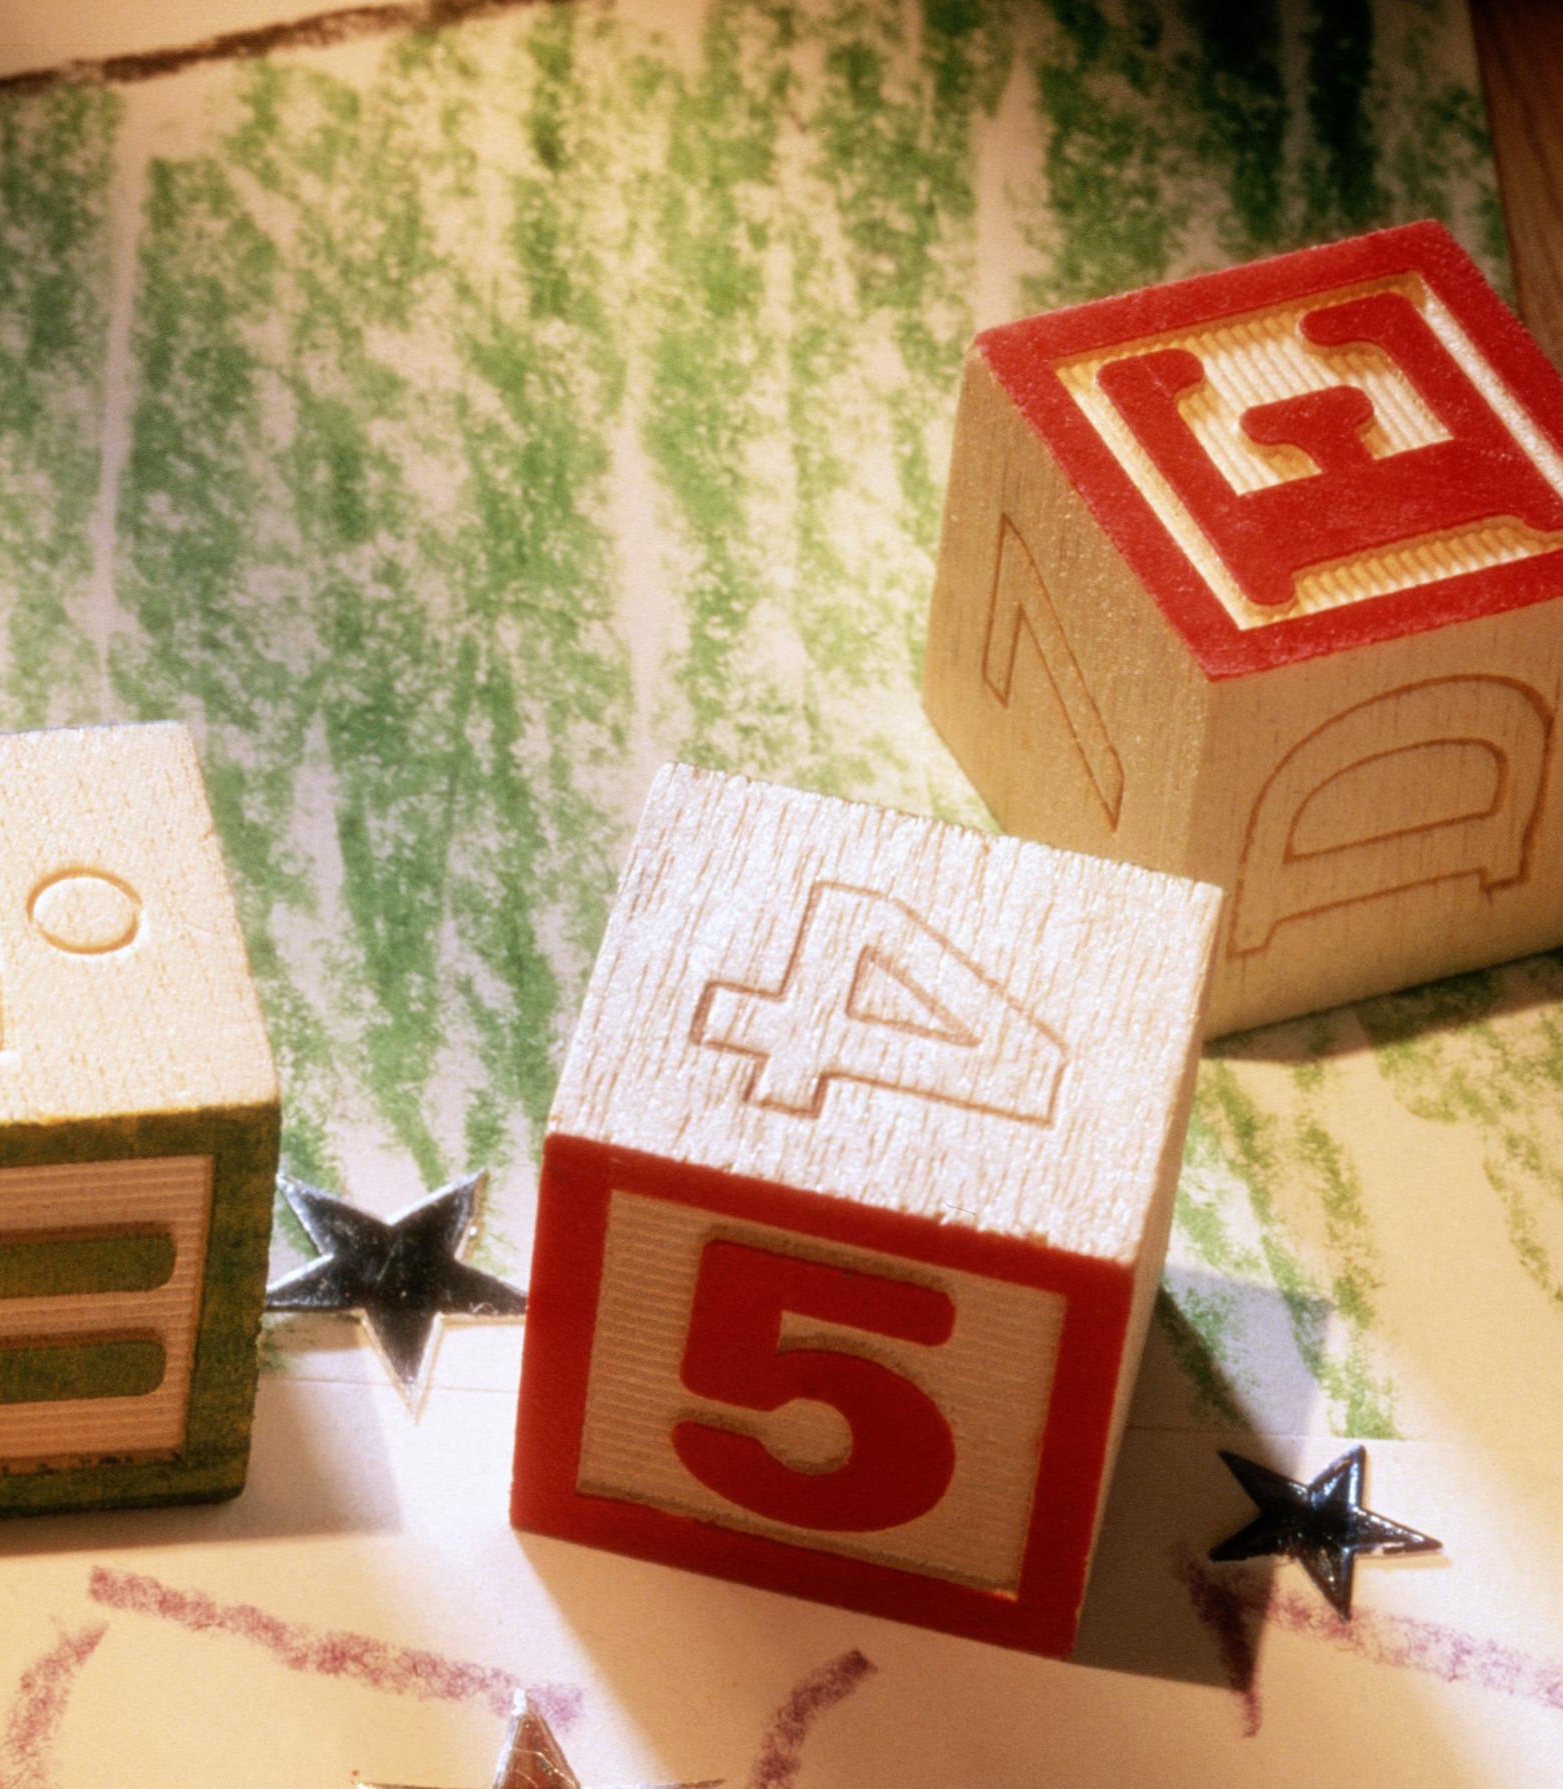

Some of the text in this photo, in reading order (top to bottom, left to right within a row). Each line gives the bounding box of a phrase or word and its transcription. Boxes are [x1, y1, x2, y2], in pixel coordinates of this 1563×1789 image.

[1096, 292, 1563, 607] E
[1225, 672, 1553, 957] D
[690, 879, 1066, 1128] 4
[672, 1237, 957, 1533] 5
